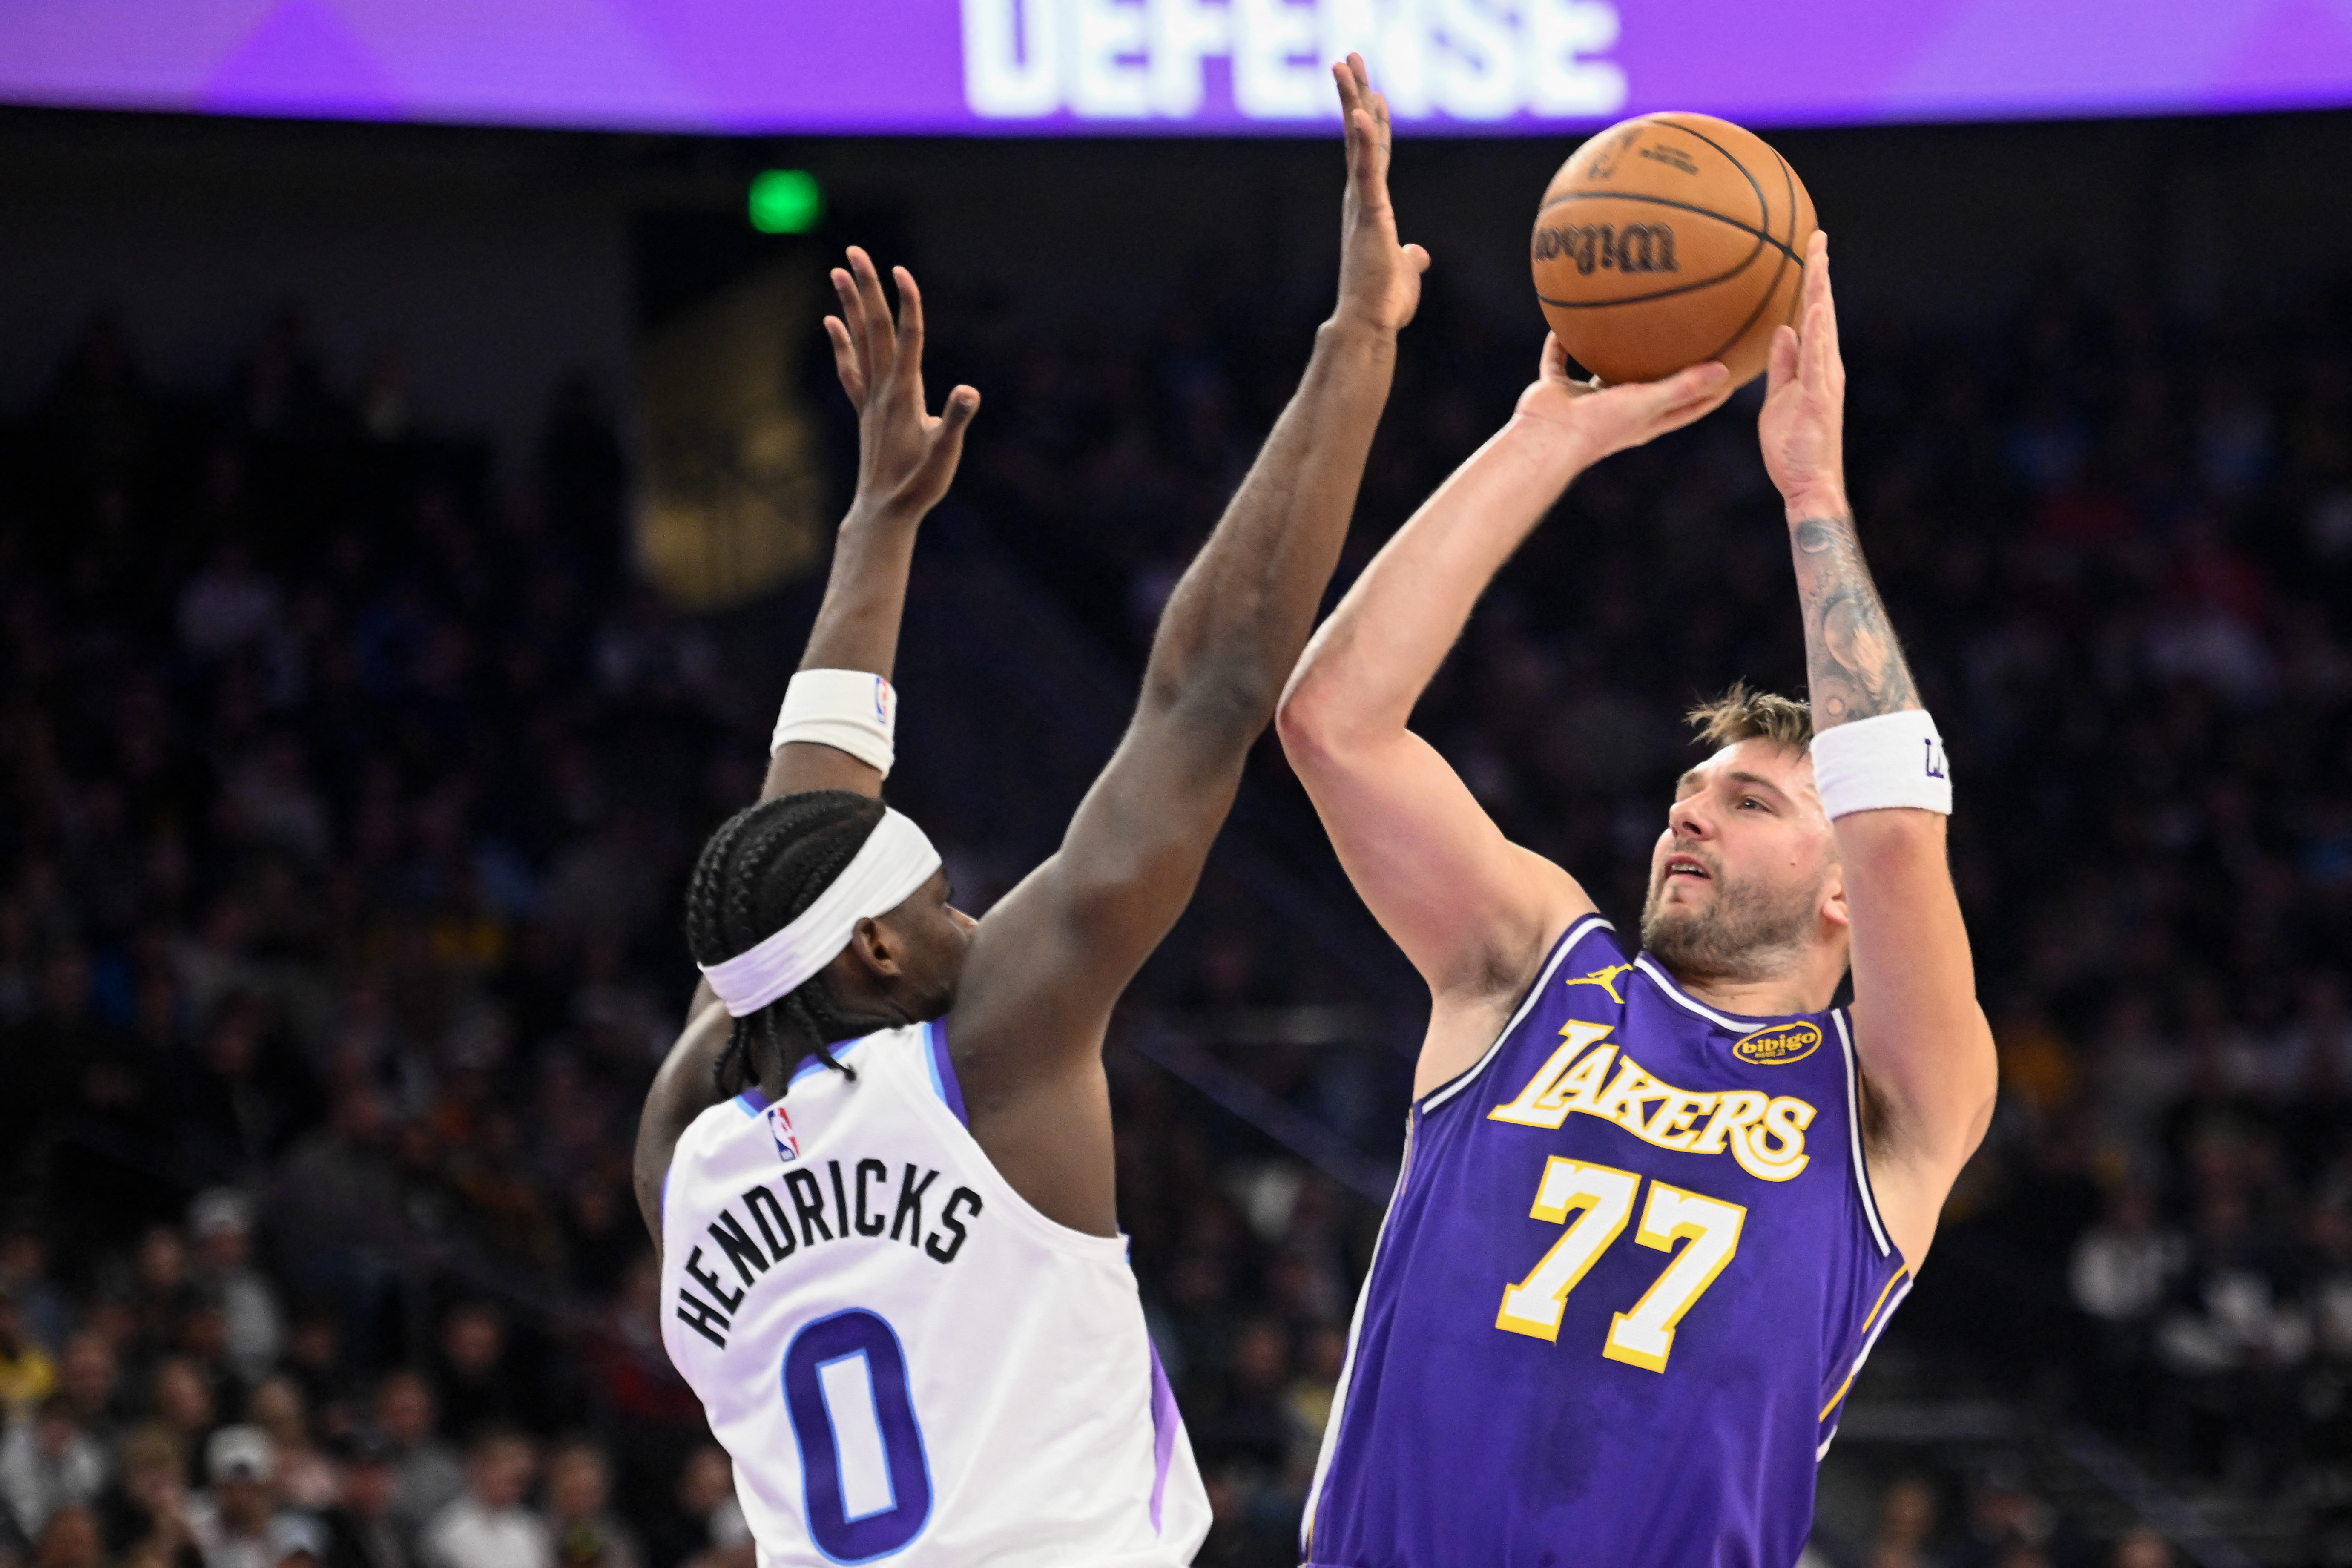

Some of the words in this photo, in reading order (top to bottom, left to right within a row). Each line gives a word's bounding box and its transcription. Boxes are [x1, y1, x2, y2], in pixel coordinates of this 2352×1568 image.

[1487, 1019, 1817, 1182] LAKERS
[1742, 1032, 1816, 1054] bibigo
[677, 1158, 983, 1350] HENDRICKS
[1496, 1155, 1747, 1374] 77
[781, 1307, 934, 1566] 0
